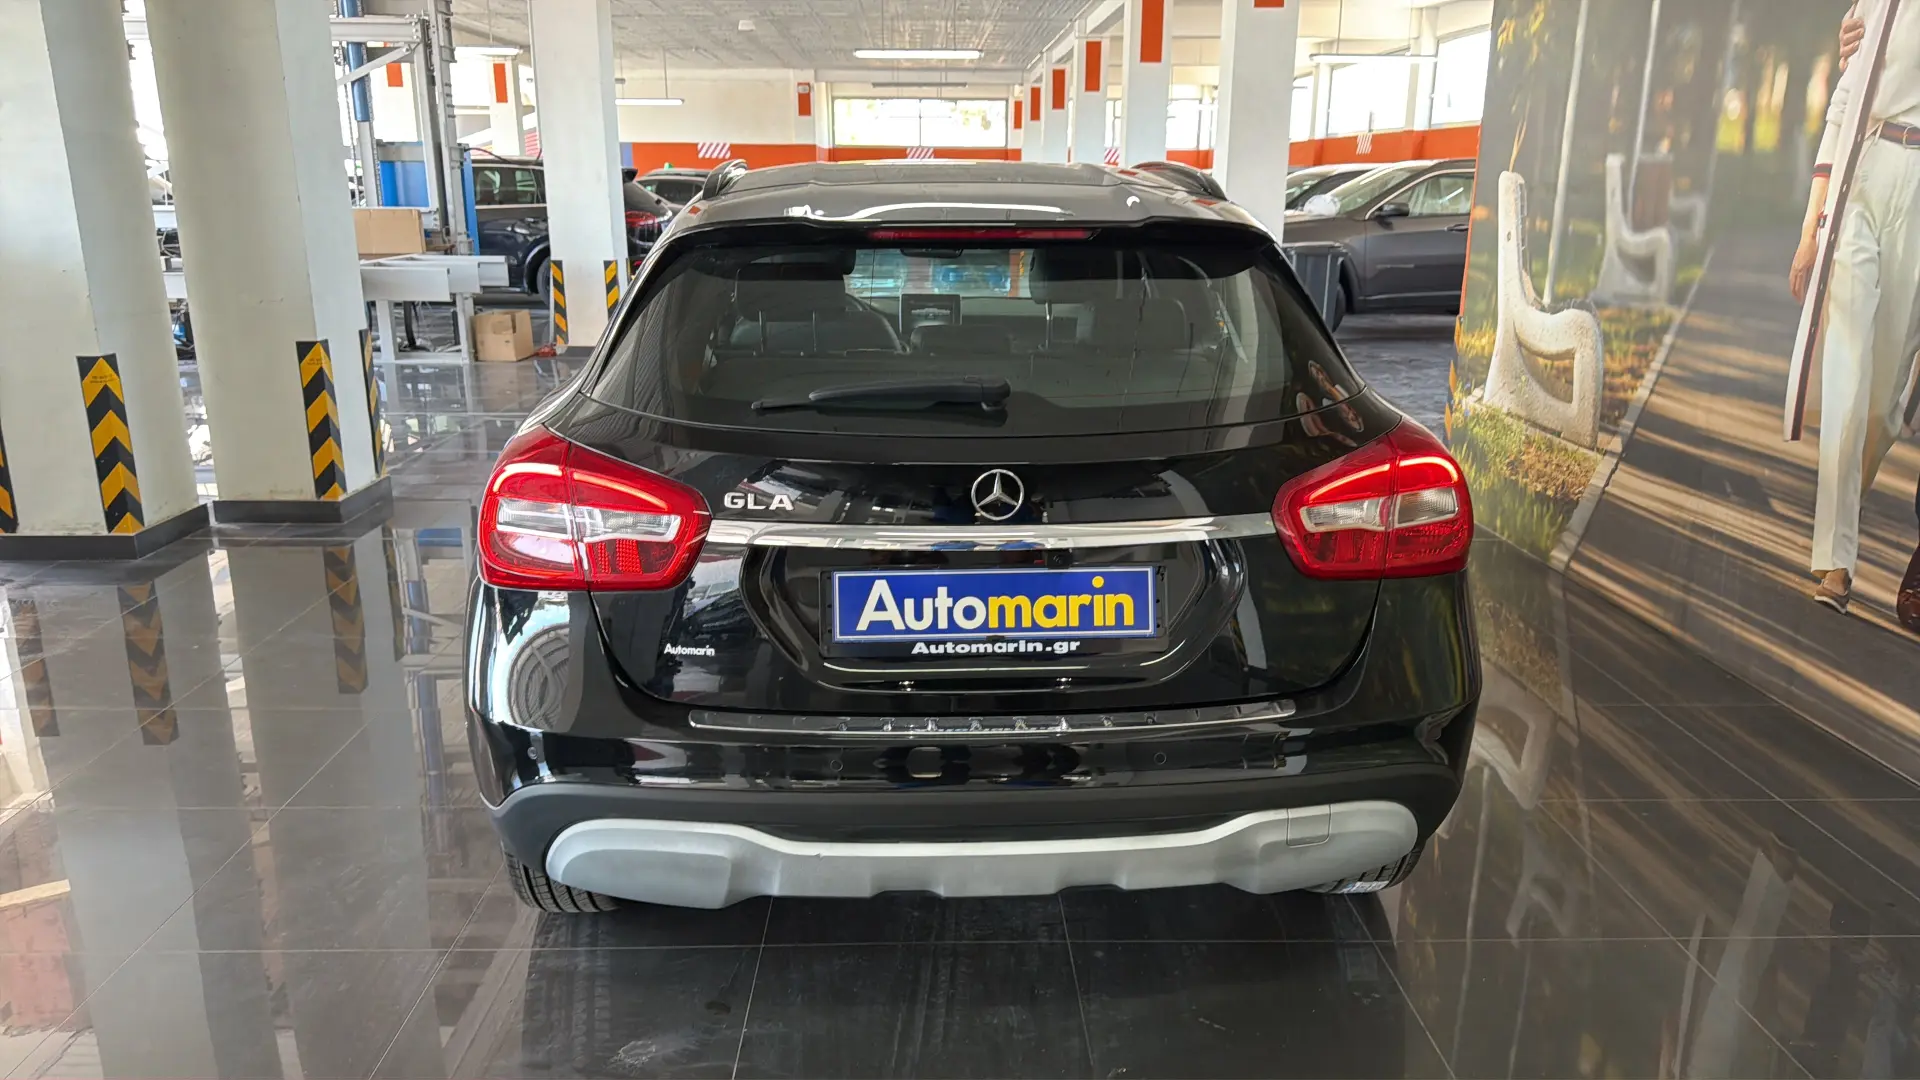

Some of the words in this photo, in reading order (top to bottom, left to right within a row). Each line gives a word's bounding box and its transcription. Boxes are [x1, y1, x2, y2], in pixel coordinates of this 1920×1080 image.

[724, 492, 794, 510] GLA
[856, 576, 1134, 631] Automarin
[664, 643, 715, 656] Automarin
[911, 640, 1080, 655] Automarin.gr
